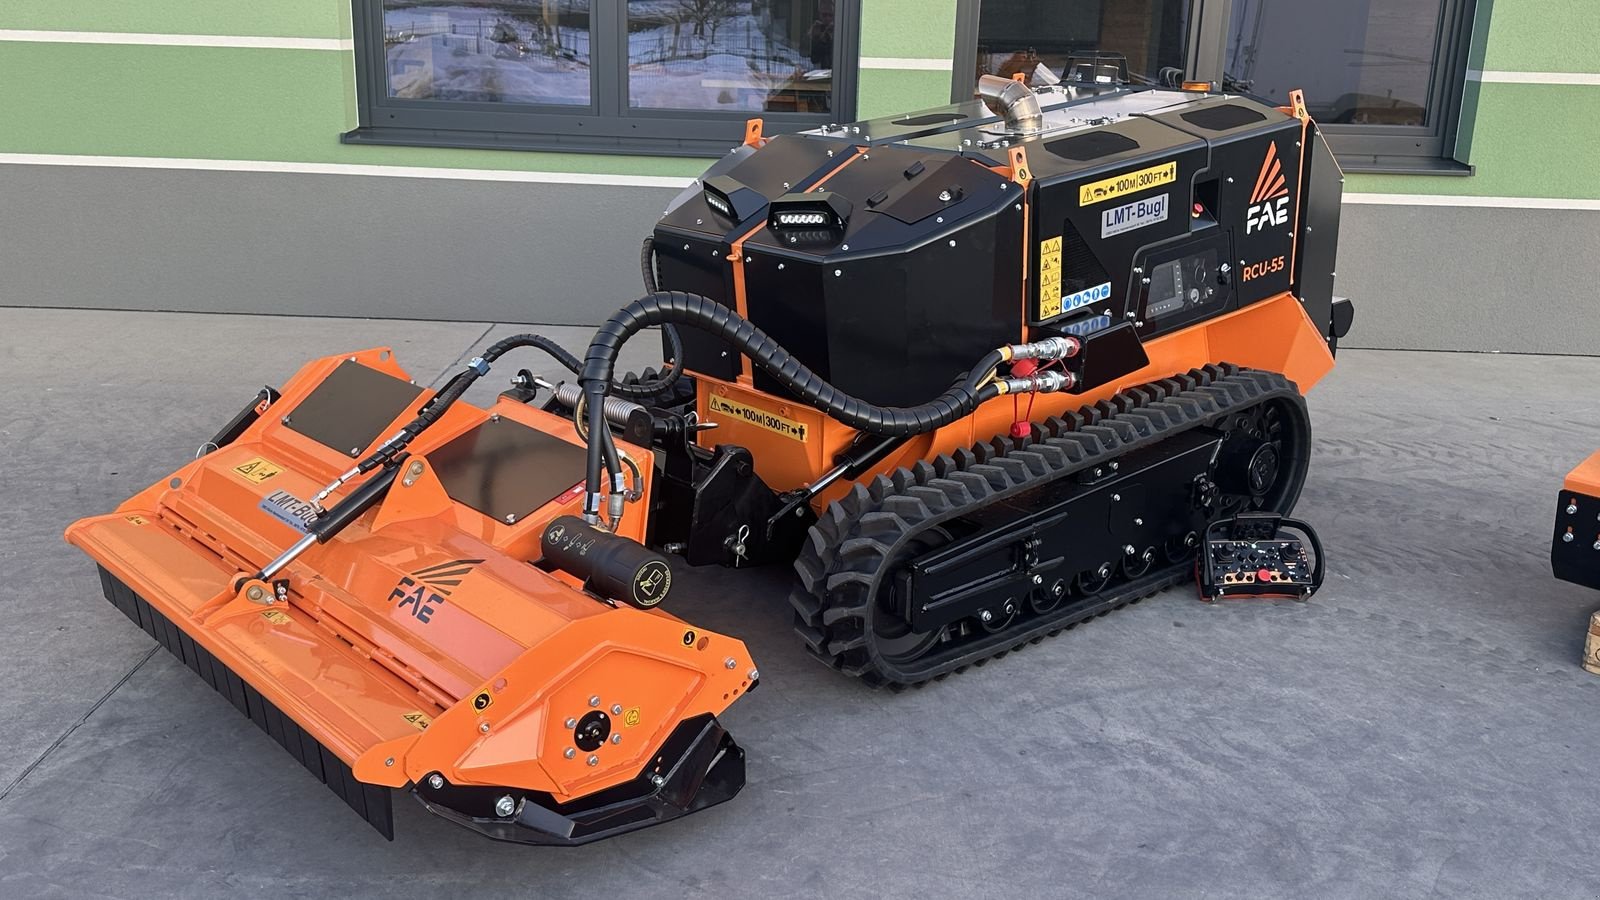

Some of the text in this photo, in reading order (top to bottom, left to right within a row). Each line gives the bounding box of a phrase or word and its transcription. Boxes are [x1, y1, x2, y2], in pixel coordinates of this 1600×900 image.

[1246, 196, 1290, 235] FAE
[1243, 255, 1285, 282] RCU-55
[387, 576, 445, 624] FAE
